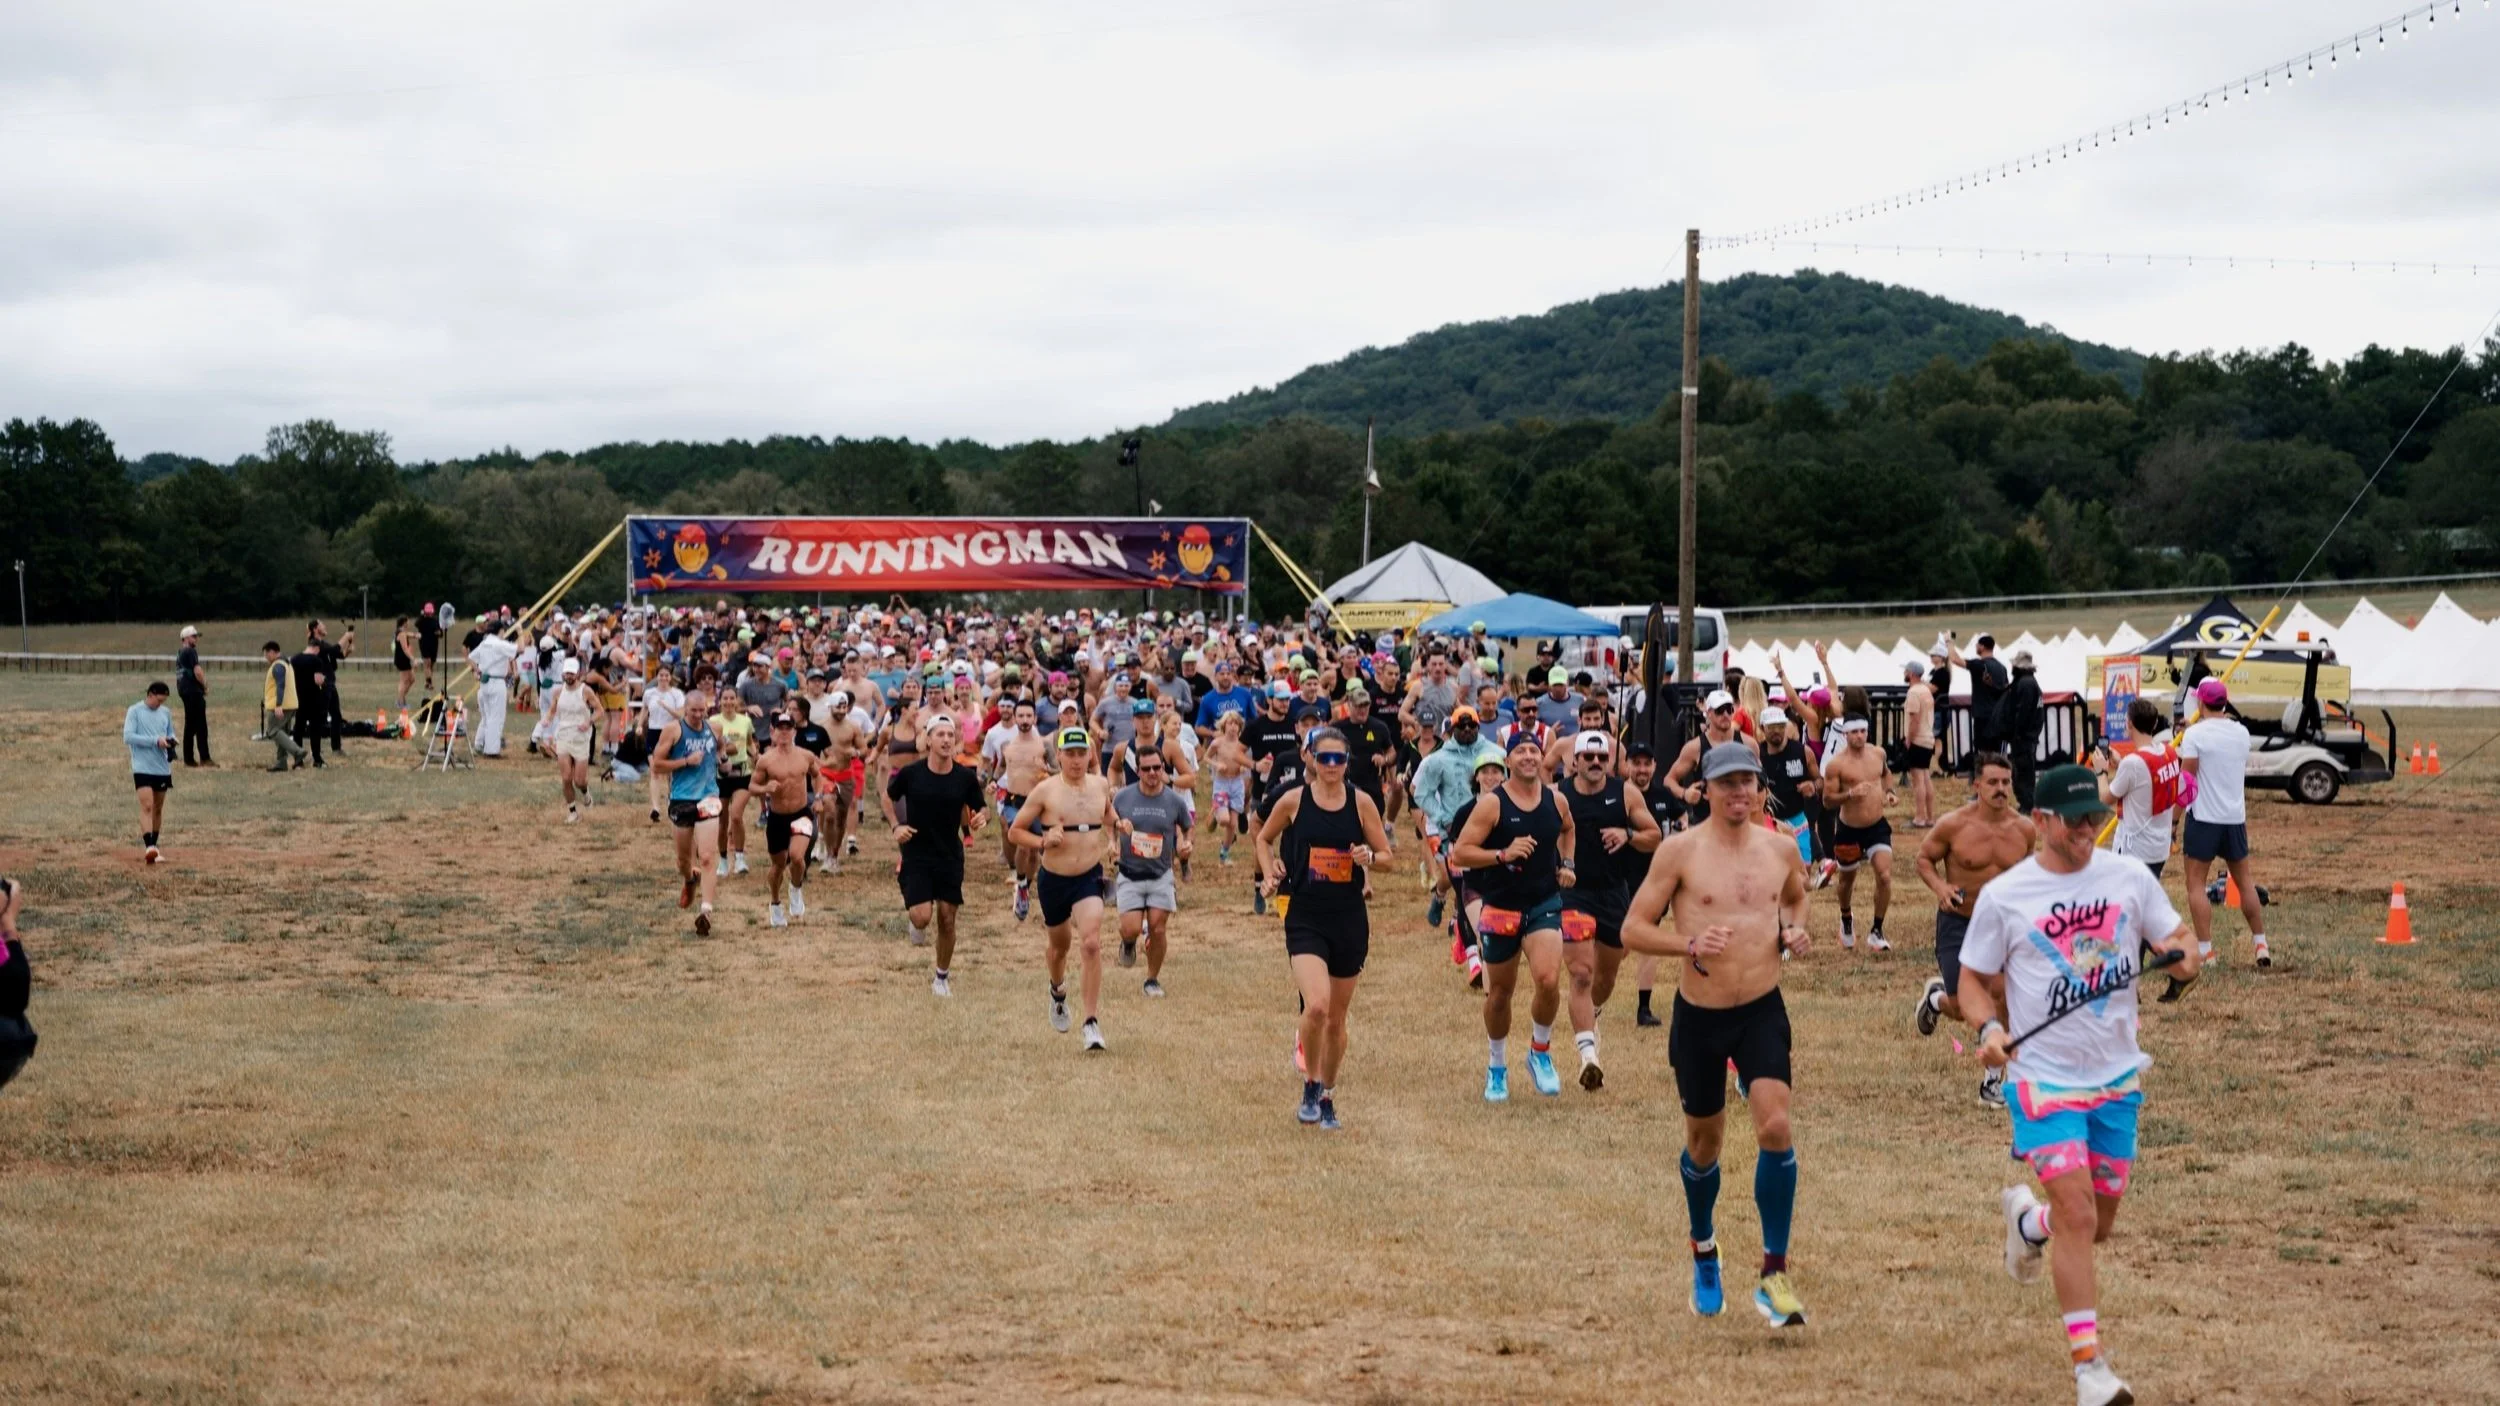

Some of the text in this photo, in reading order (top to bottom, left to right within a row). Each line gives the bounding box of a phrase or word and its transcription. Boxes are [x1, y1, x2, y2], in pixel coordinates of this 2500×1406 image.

[748, 529, 1128, 576] RUNNINGMAN
[1348, 609, 1405, 617] JUNCTION
[2106, 712, 2128, 721] MEDA
[2110, 721, 2127, 730] TEN
[2045, 897, 2110, 938] Stay
